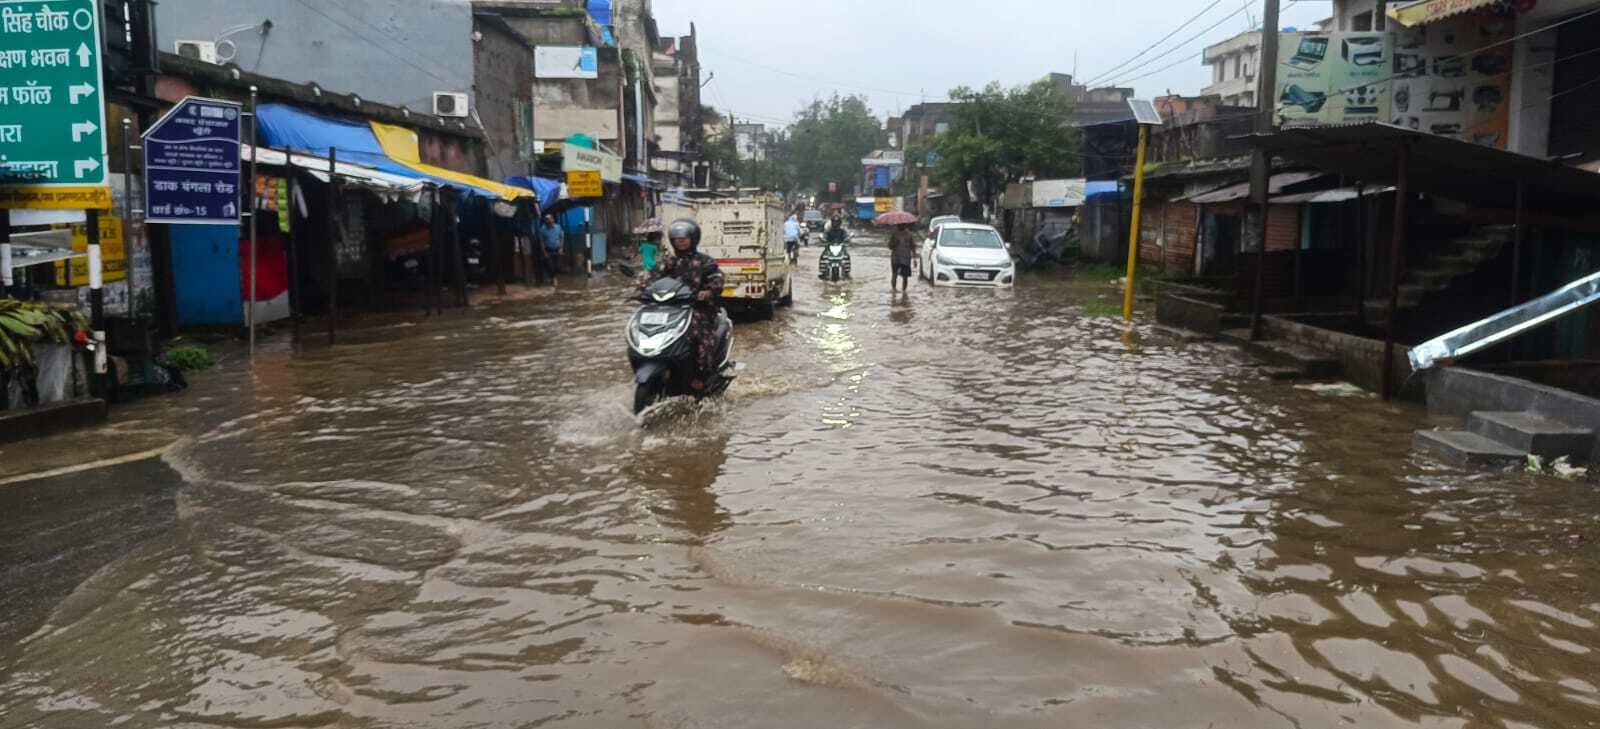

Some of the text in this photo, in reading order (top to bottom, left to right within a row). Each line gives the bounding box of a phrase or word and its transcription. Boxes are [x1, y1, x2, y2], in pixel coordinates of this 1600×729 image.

[2, 4, 69, 33] सिंह चौक
[31, 48, 70, 67] भवन
[12, 80, 52, 105] फॉल
